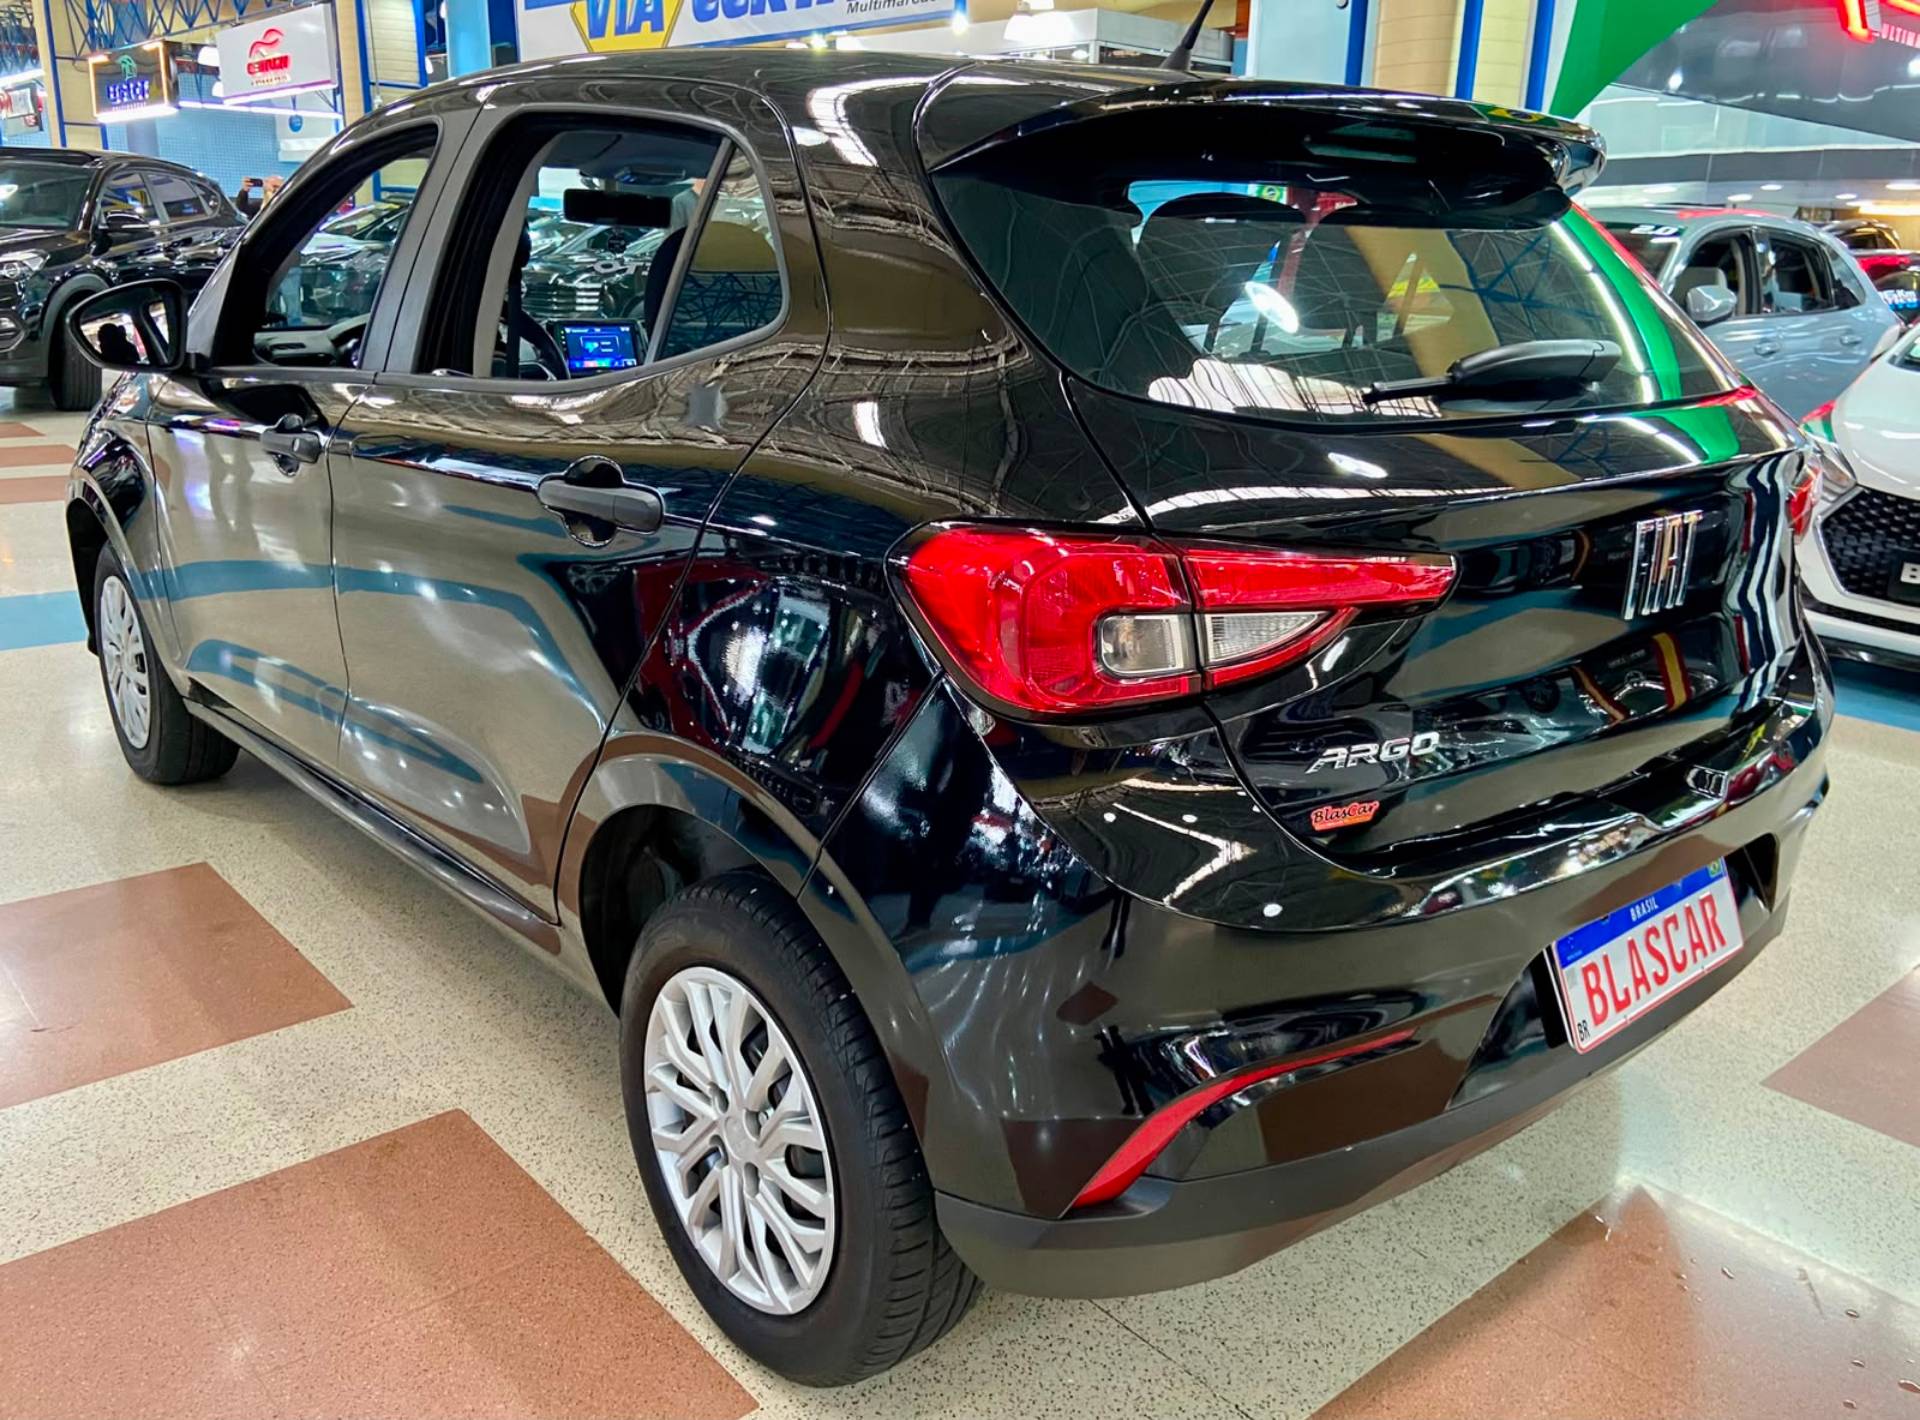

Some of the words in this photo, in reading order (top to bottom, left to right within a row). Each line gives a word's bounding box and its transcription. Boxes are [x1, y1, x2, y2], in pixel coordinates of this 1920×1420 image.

[587, 0, 664, 39] VIA
[1630, 224, 1679, 236] 2.0
[1624, 509, 1704, 620] FIAT
[1305, 731, 1440, 774] ARGO
[1313, 802, 1378, 824] BlasCar
[1630, 896, 1659, 922] BRASIL
[1581, 893, 1727, 1027] BLASCAR
[1577, 1019, 1590, 1042] BR
